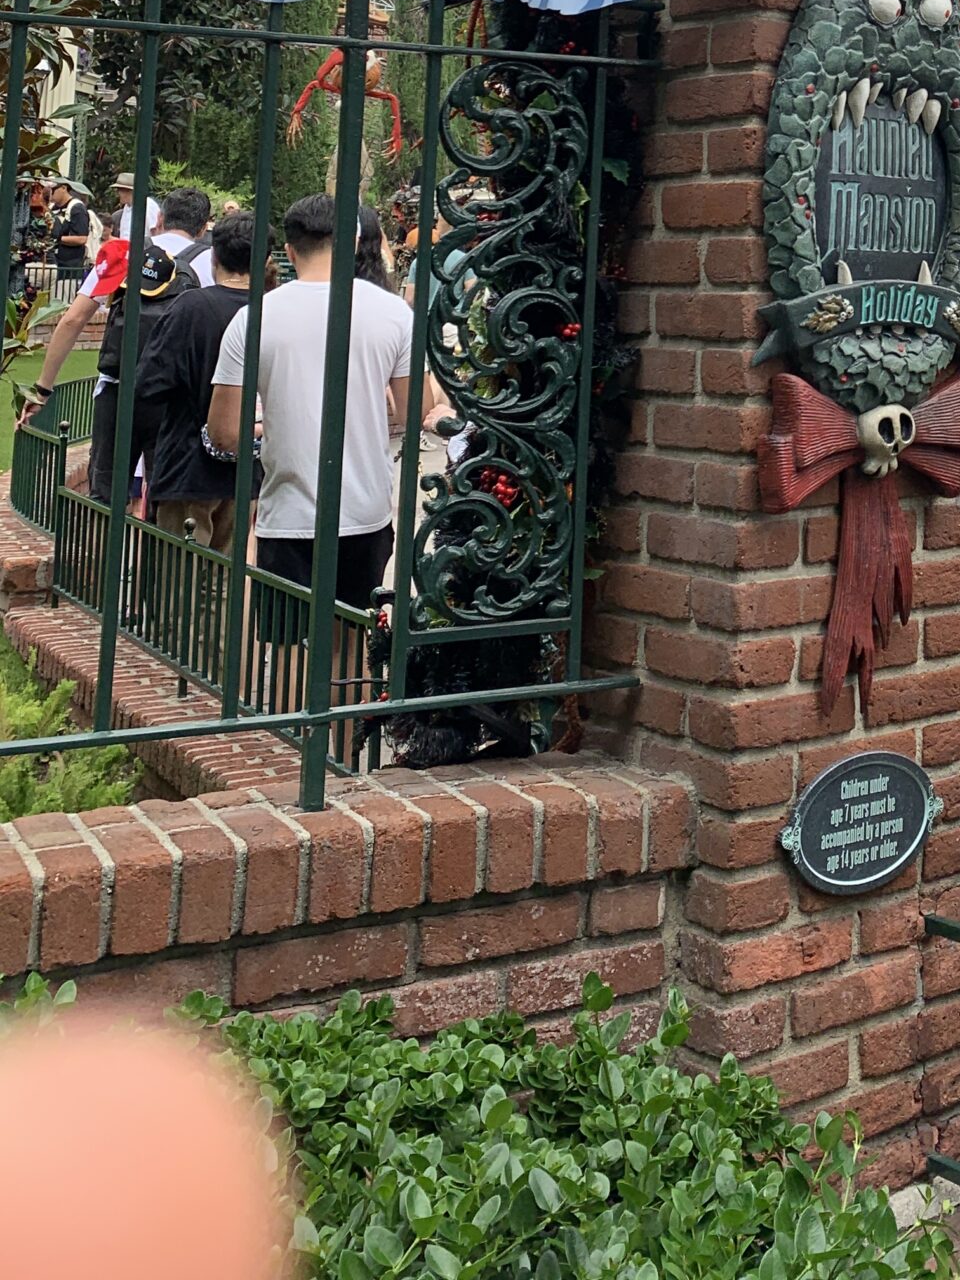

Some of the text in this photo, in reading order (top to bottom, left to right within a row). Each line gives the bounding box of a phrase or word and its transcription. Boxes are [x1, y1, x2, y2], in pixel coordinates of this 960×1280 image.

[829, 111, 936, 182] Haunted
[823, 181, 936, 260] Mansion
[860, 284, 940, 328] Holiday
[841, 773, 890, 800] Children under
[830, 794, 896, 827] age 7 years must be
[821, 817, 904, 850] accompanied by a person
[827, 839, 899, 874] age 14 years or older.
